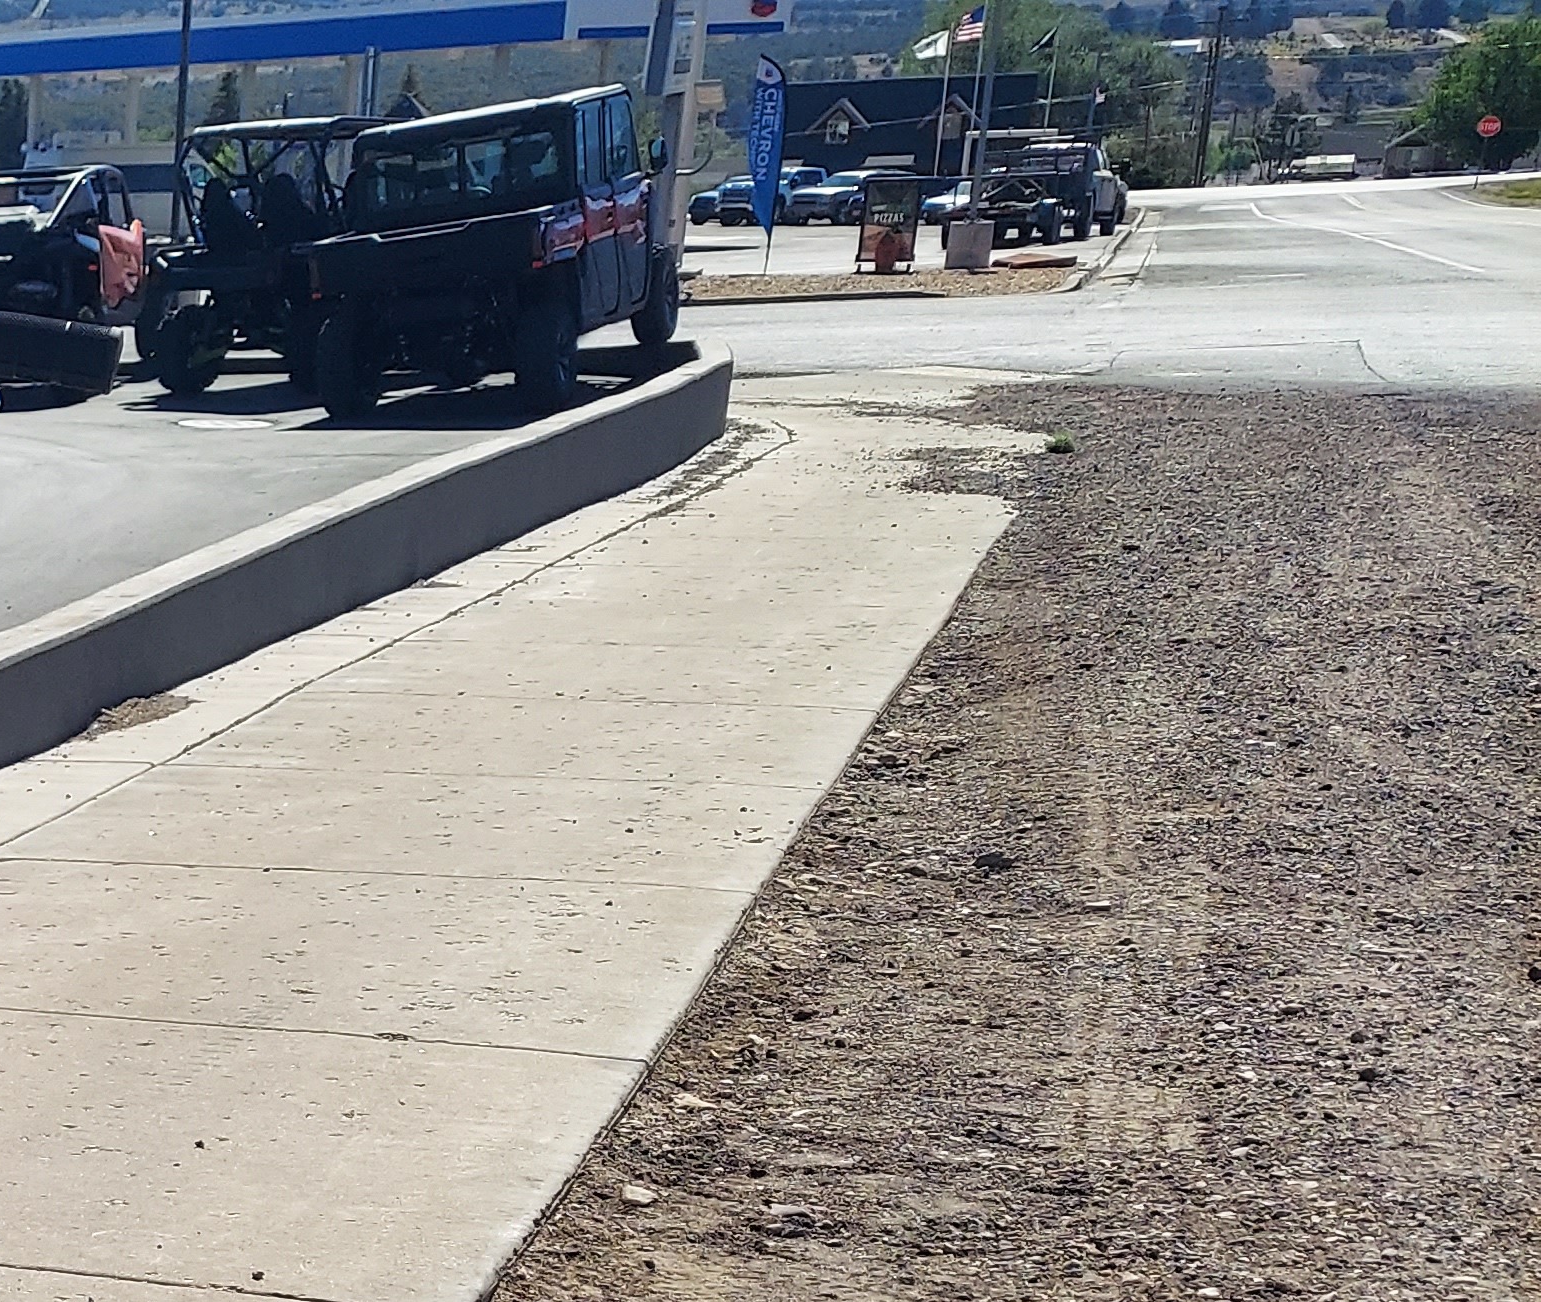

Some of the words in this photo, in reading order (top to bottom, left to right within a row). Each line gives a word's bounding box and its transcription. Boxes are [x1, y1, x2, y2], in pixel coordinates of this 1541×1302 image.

[753, 87, 765, 121] WITH
[755, 88, 778, 180] CHEVRON
[874, 213, 905, 223] PIZZAS
